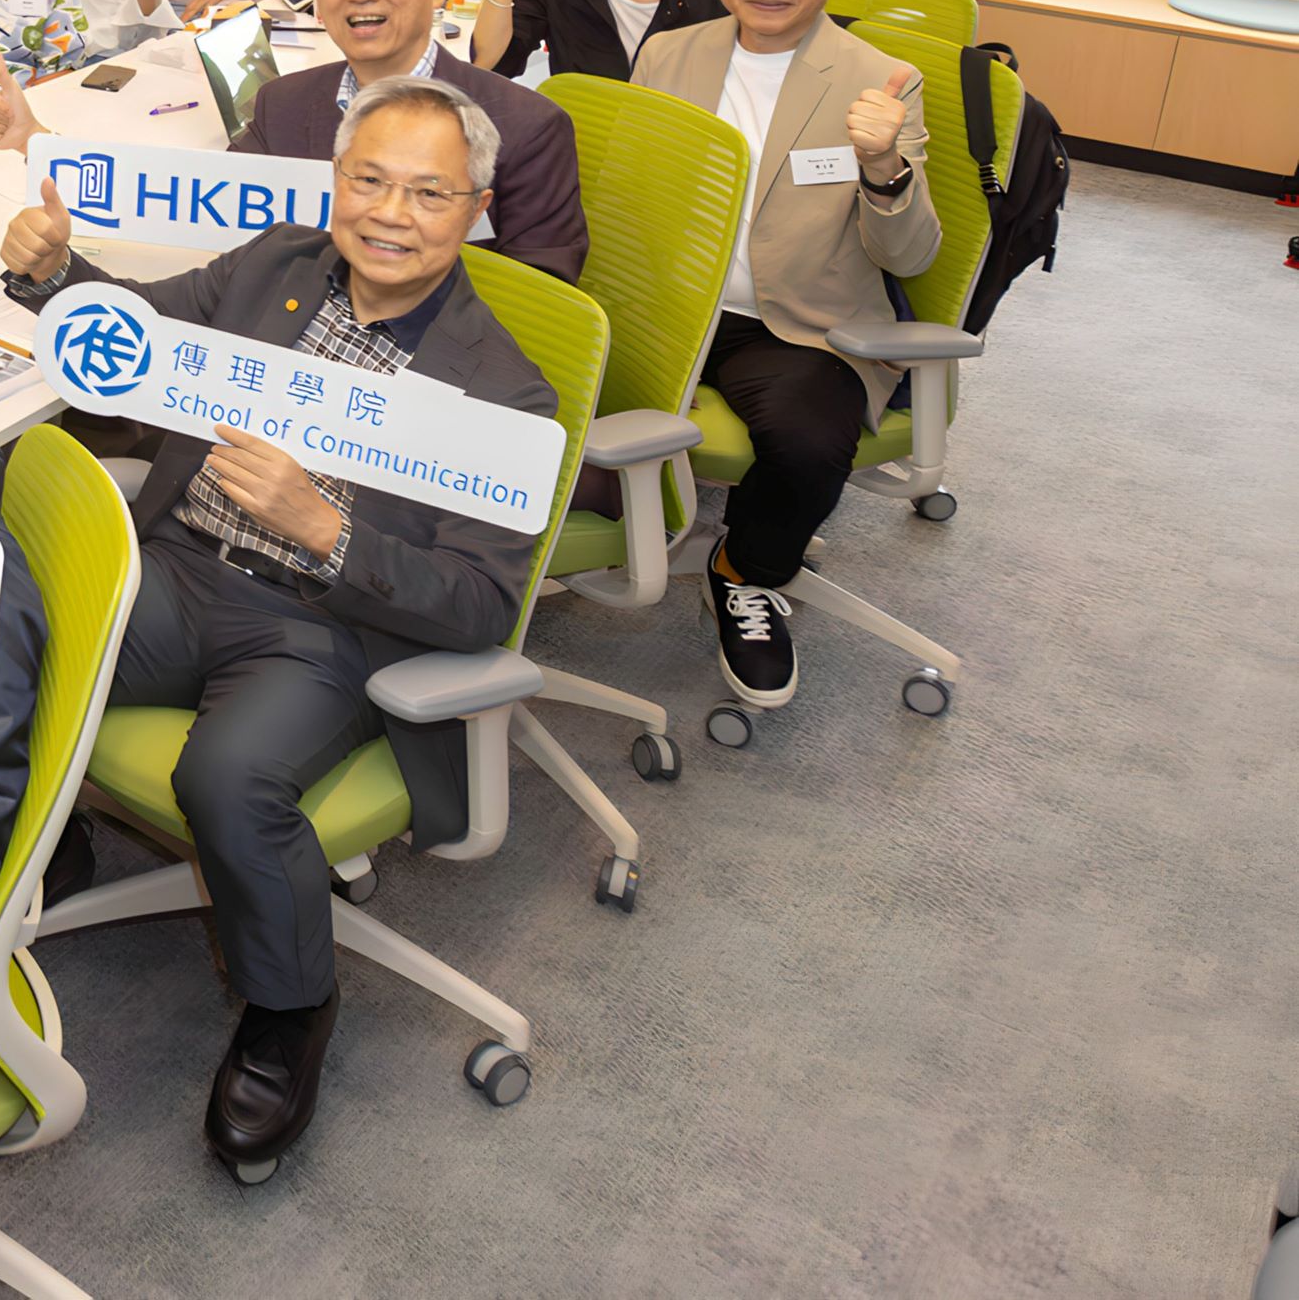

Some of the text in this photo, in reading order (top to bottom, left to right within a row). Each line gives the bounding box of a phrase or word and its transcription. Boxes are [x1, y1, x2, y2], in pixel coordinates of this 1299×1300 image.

[136, 173, 331, 231] HKBU
[172, 339, 387, 428] 傳理學院
[163, 386, 529, 511] School of Communication
